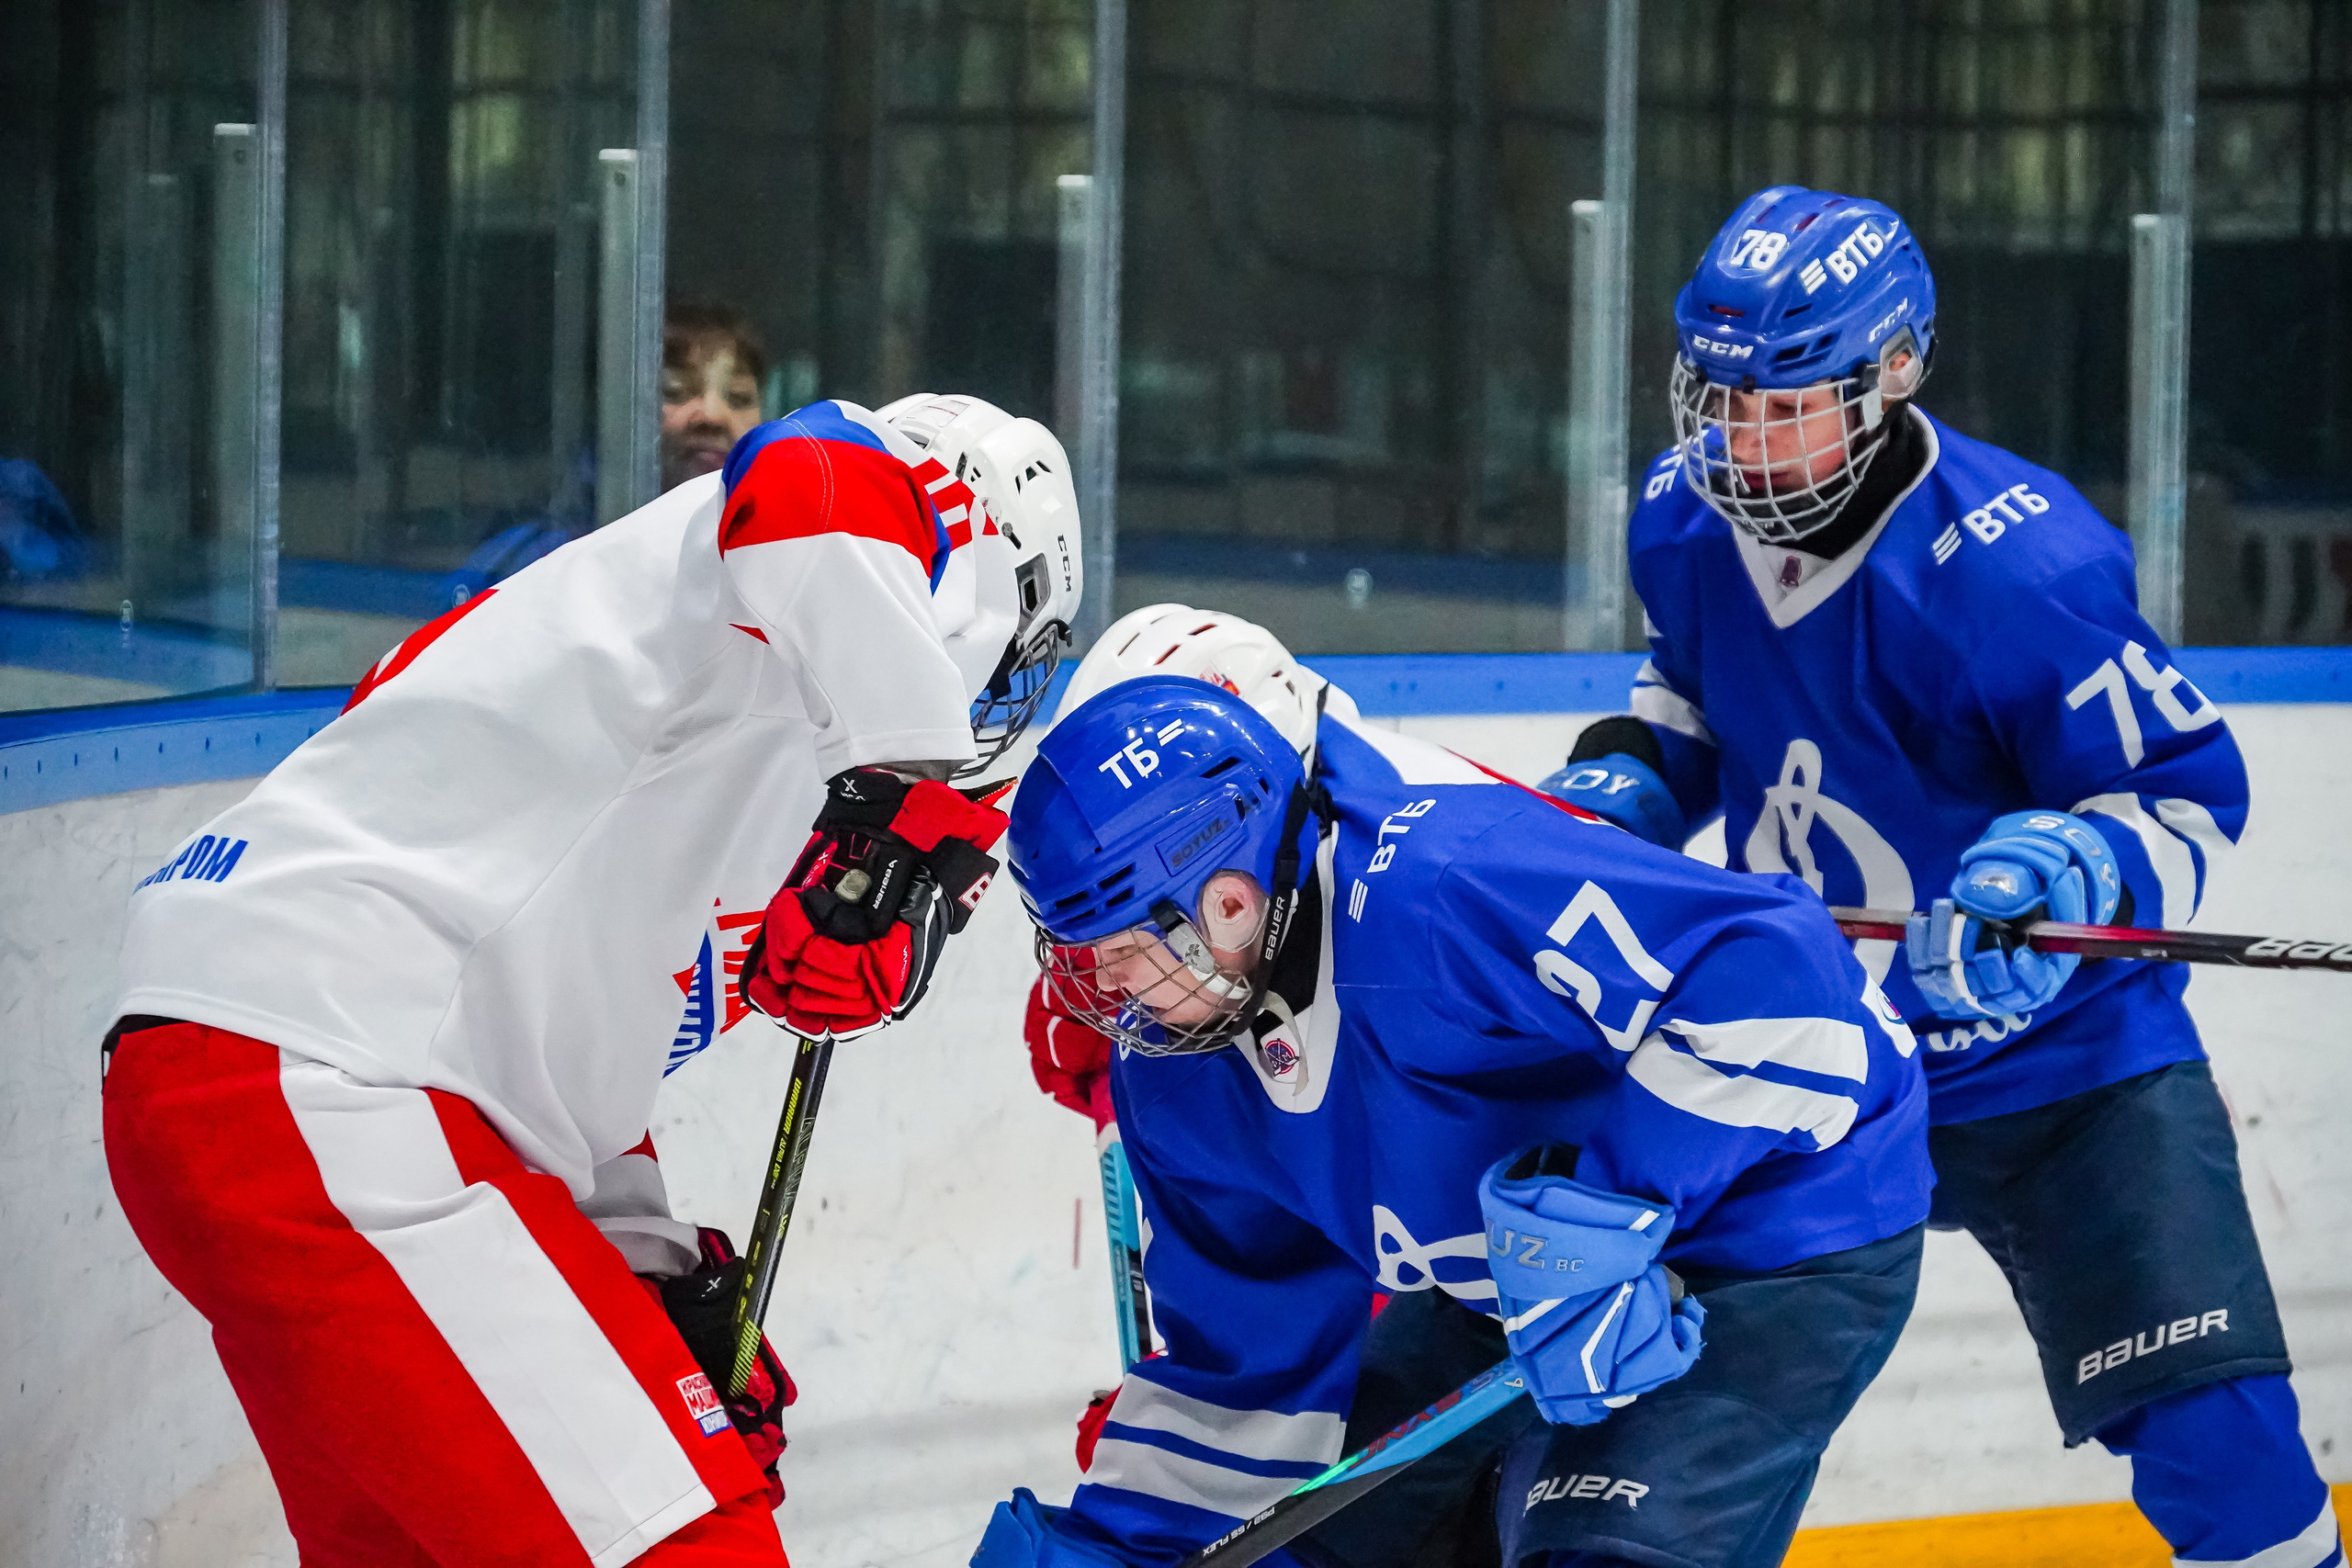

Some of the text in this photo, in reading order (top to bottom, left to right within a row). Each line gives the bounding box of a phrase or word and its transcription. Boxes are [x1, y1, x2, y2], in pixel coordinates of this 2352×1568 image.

[1731, 229, 1787, 270] 78
[1825, 221, 1885, 285] ВТБ
[1691, 333, 1754, 359] CCM
[1868, 297, 1908, 343] CCM
[1963, 482, 2050, 546] ВТБ
[1057, 534, 1072, 592] CCM
[2066, 639, 2221, 769] 78
[1366, 798, 1437, 874] ВТБ
[1264, 896, 1285, 963] BAUER
[1533, 879, 1674, 1053] 27
[783, 1077, 802, 1135] WARRIOR
[1556, 1258, 1585, 1272] BC
[2078, 1308, 2230, 1385] BAUER
[1202, 1534, 1229, 1558] FLEX
